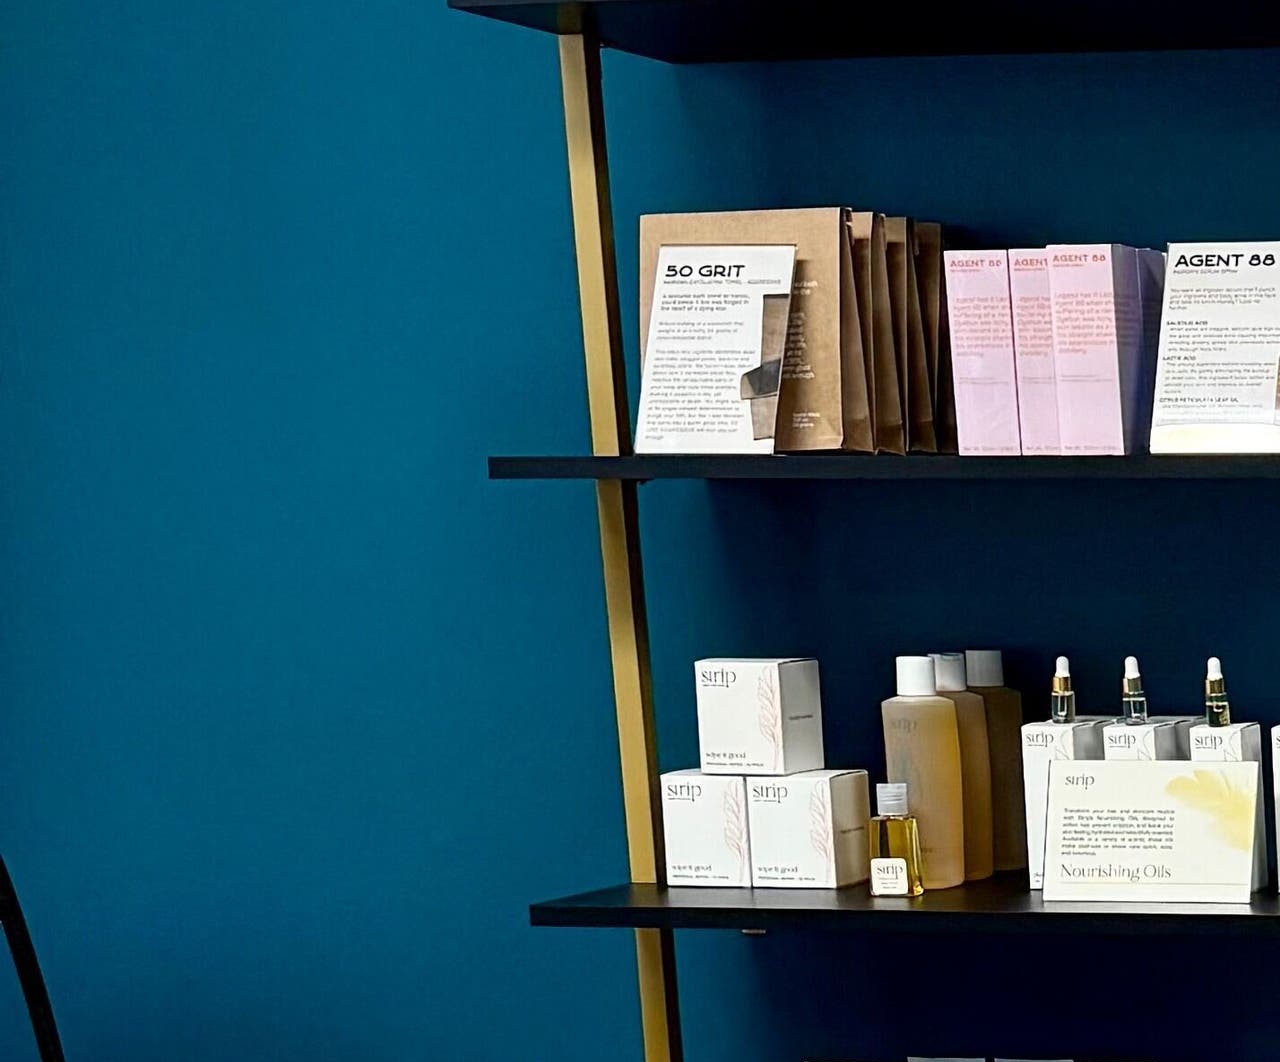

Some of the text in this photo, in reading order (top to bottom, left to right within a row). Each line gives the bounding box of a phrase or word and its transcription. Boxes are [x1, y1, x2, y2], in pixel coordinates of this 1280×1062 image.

[1175, 254, 1276, 267] AGENT 88
[665, 265, 746, 277] 50 GRIT
[1065, 773, 1095, 790] strip
[1061, 864, 1172, 881] Nourishing Oils
